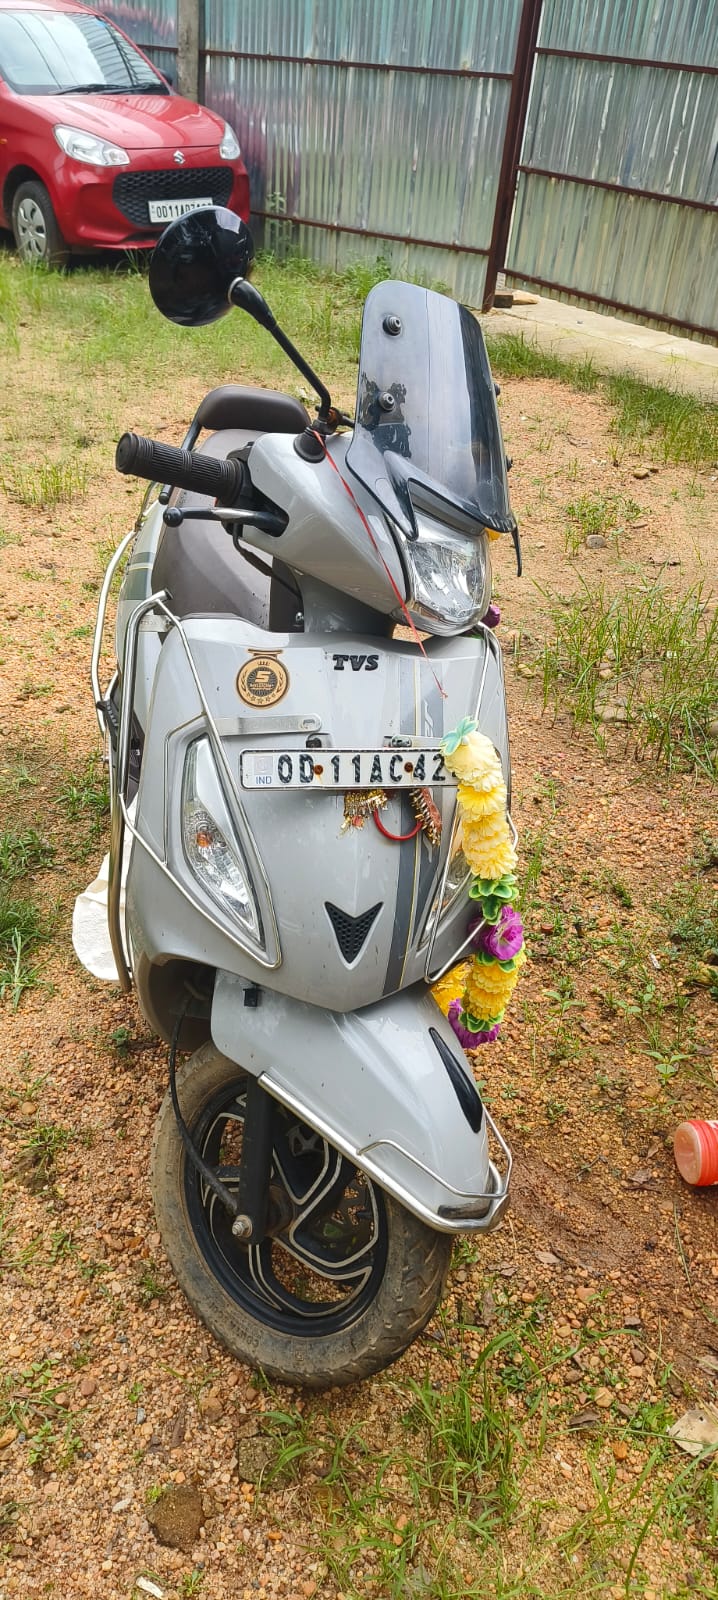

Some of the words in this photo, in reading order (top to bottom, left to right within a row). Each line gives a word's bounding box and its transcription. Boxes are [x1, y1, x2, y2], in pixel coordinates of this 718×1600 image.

[332, 653, 380, 672] TVS
[413, 752, 457, 782] 42
[255, 776, 272, 785] IND
